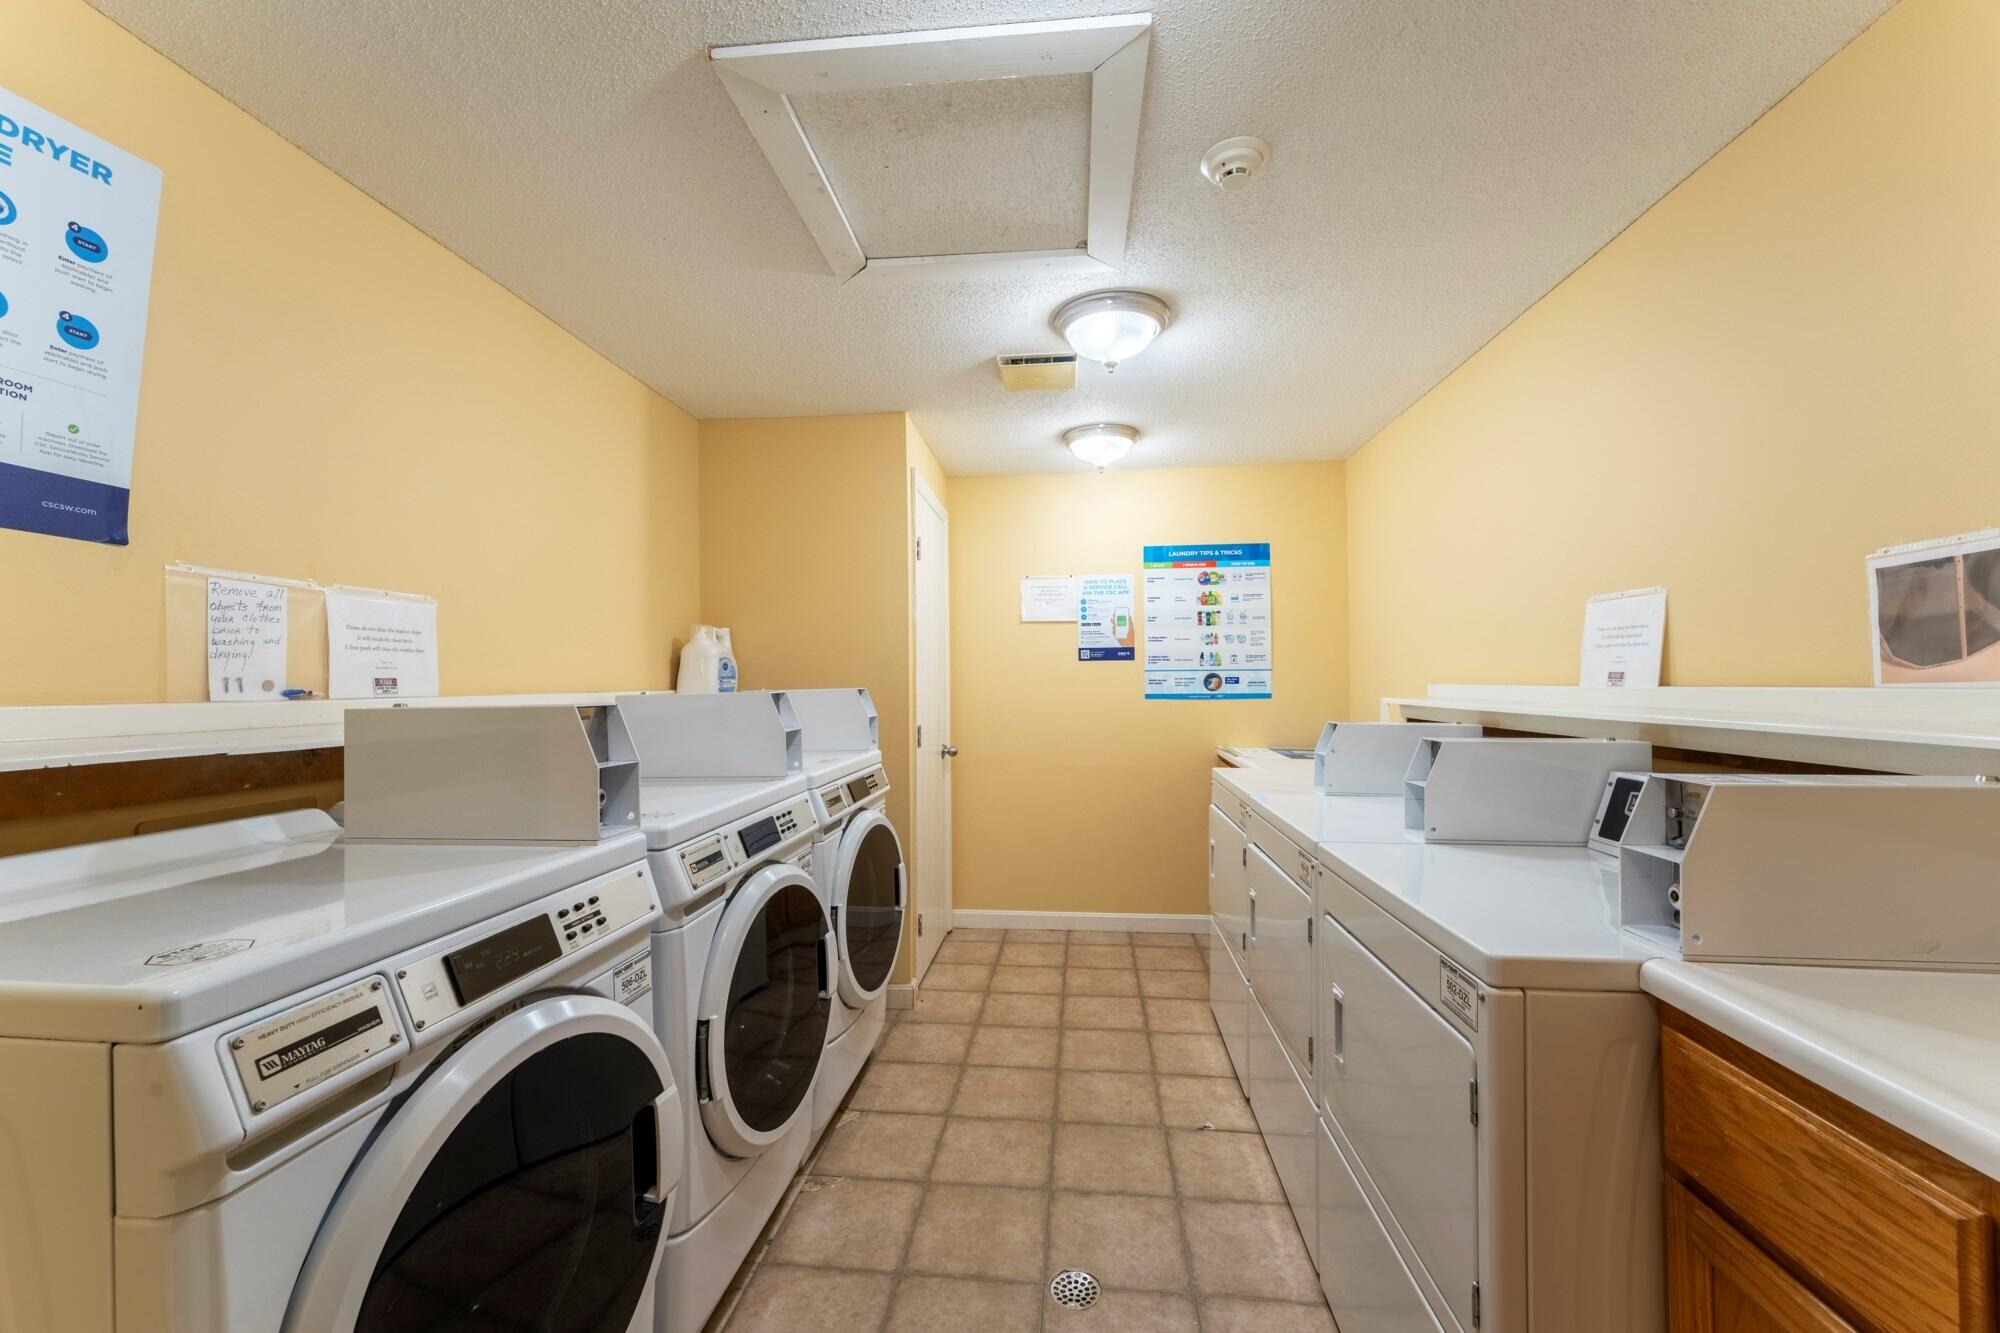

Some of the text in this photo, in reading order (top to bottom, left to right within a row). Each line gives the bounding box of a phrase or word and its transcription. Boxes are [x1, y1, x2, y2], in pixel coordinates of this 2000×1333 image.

[0, 114, 113, 186] DRYER
[77, 239, 97, 251] START
[58, 255, 76, 266] Enter
[69, 329, 88, 338] START
[50, 344, 68, 354] Enter
[42, 500, 97, 516] cscsw.com
[209, 581, 285, 599] Remove all
[242, 612, 281, 624] clothes
[211, 634, 282, 655] washing and
[621, 969, 648, 991] 506-DZL
[1446, 978, 1472, 1008] 502-DZL
[258, 1028, 279, 1041] HEAVY
[279, 1021, 295, 1034] DUTY
[280, 1036, 327, 1064] MAYTAG
